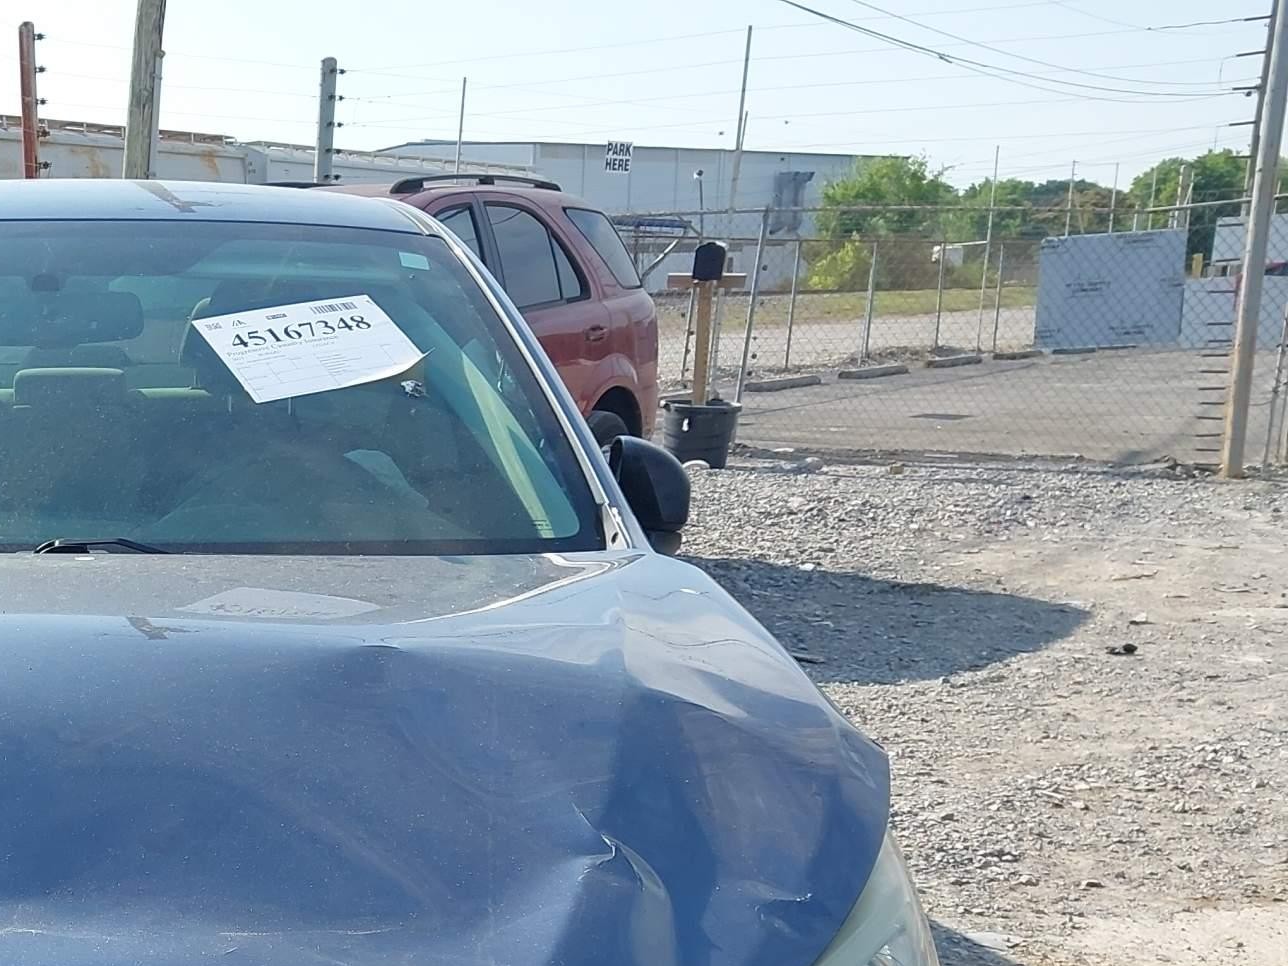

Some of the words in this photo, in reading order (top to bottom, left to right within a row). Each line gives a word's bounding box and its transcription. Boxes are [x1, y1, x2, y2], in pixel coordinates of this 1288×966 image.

[606, 142, 632, 157] PARK
[605, 158, 631, 171] HERE
[231, 315, 372, 348] 45167348
